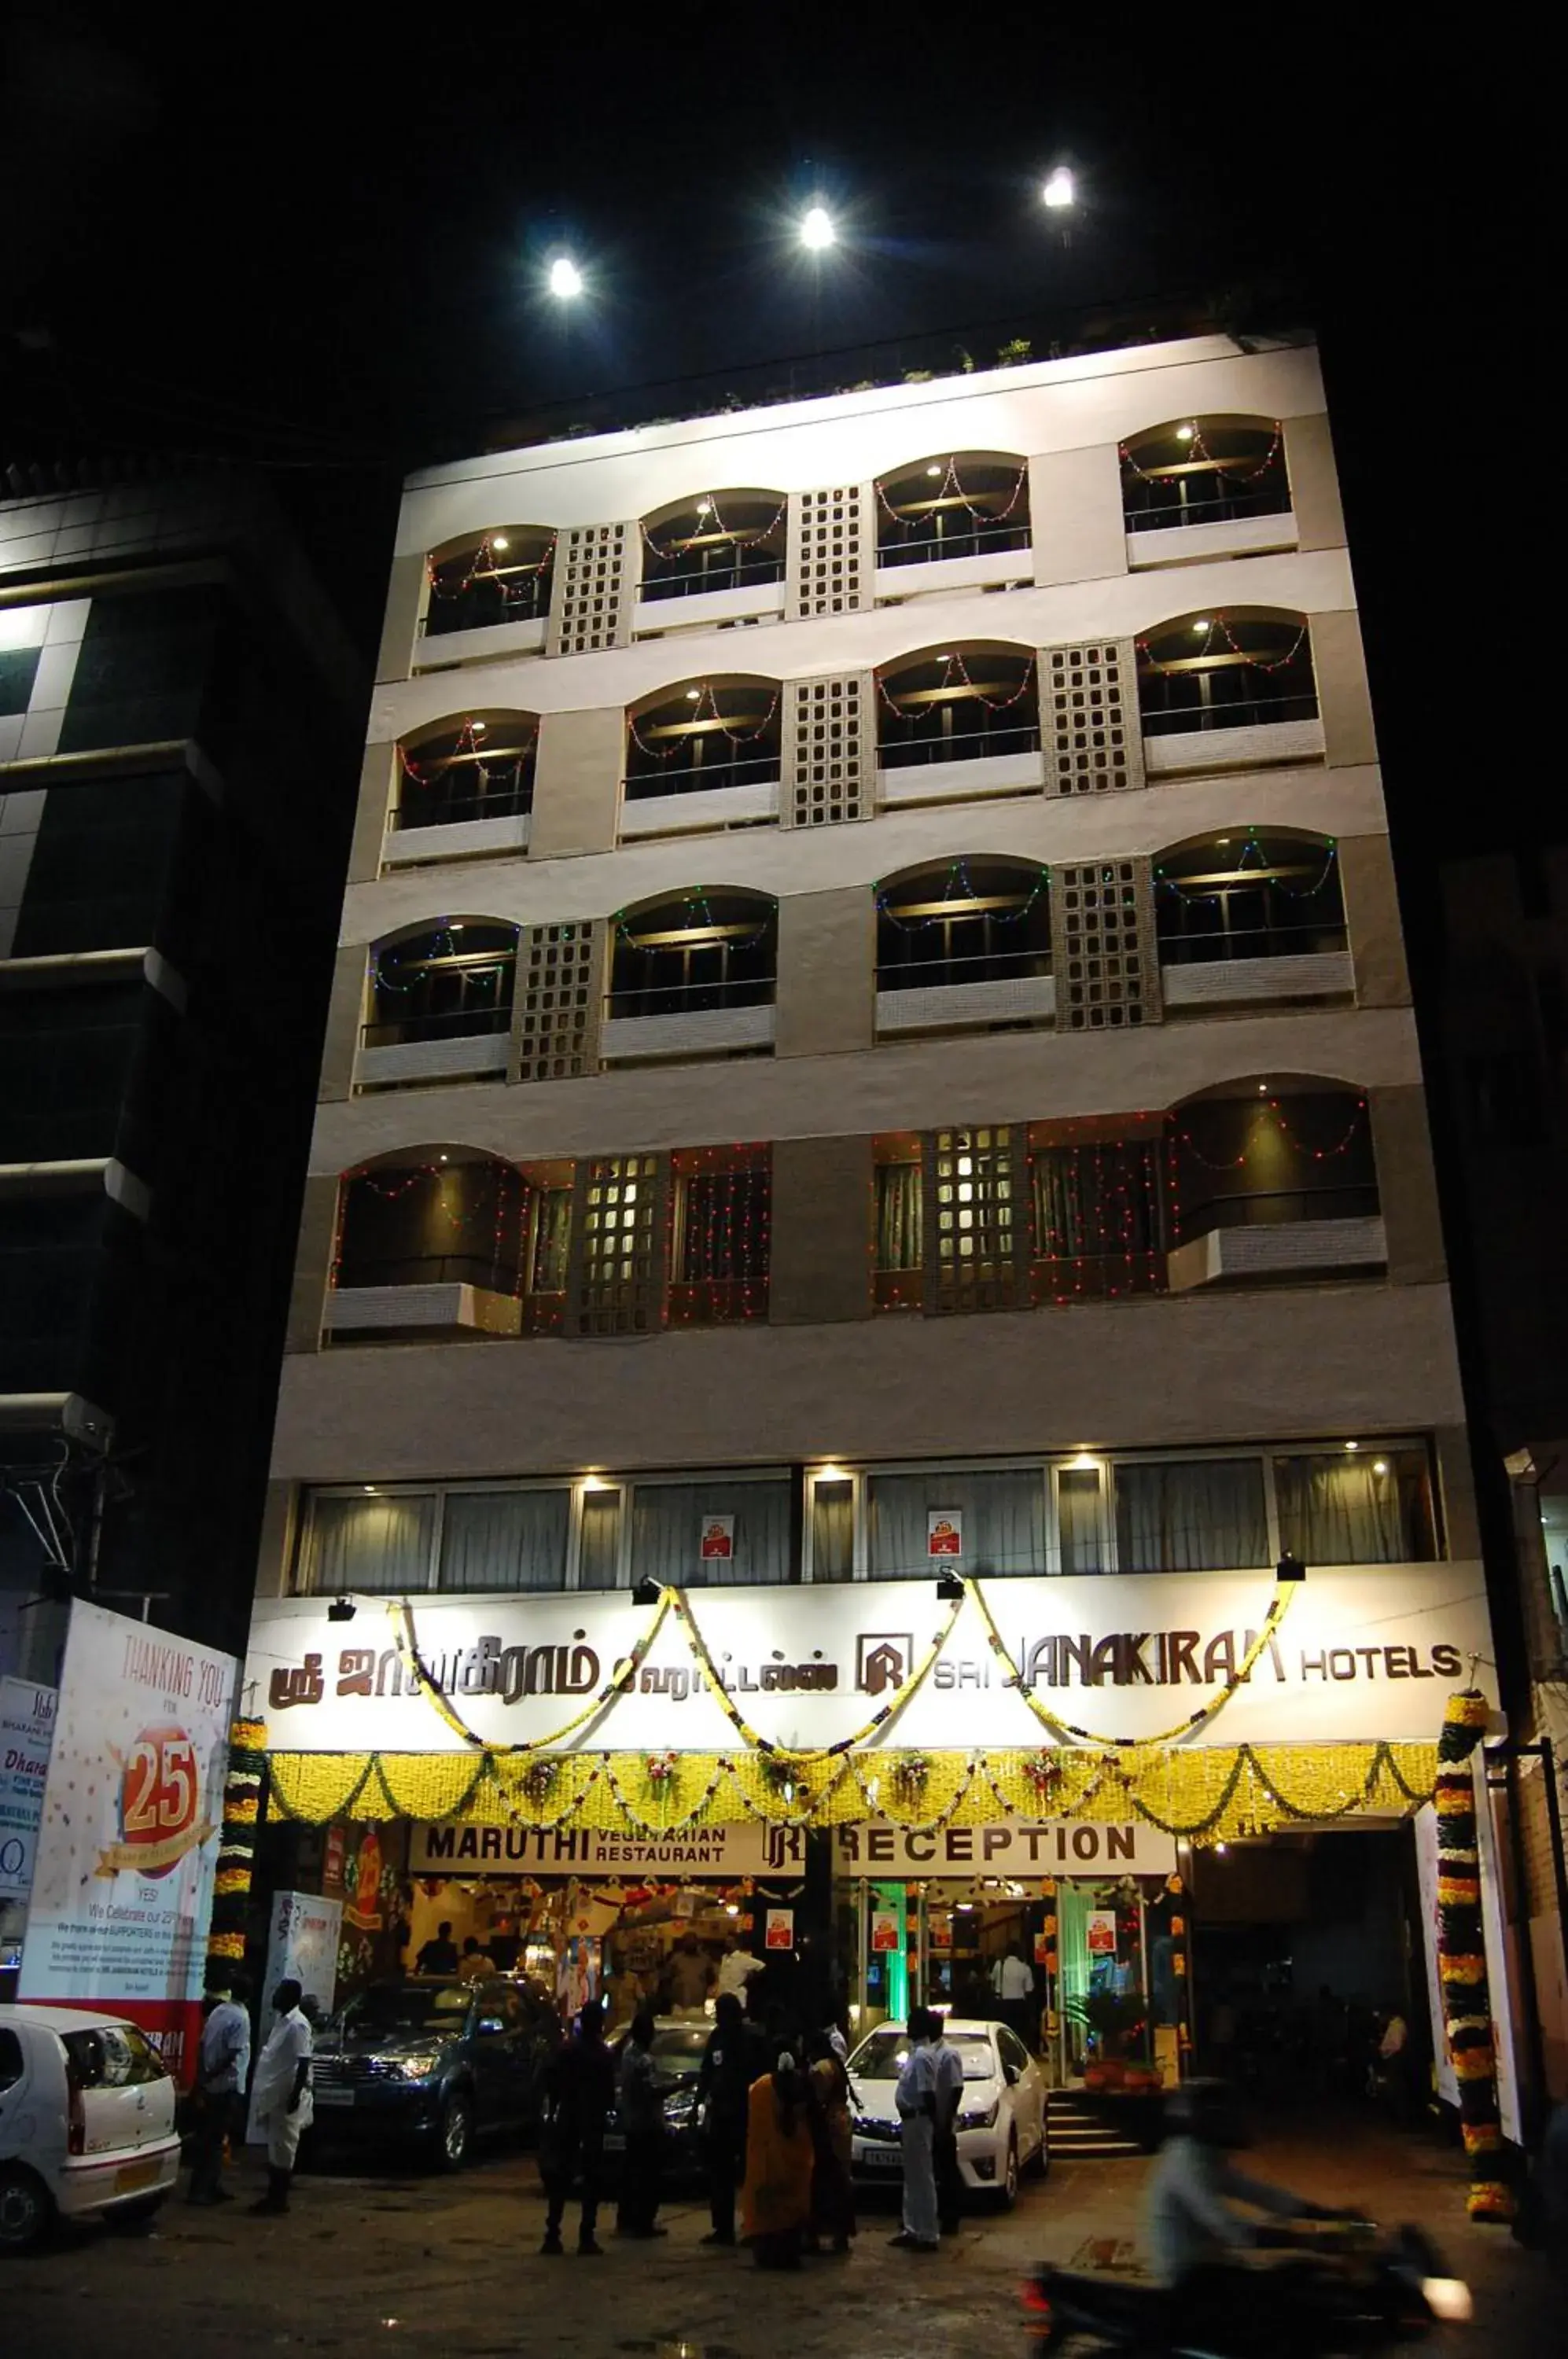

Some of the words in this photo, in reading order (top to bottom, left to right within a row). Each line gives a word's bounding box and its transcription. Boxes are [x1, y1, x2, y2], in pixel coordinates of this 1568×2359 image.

[122, 1635, 194, 1698] THANKING
[197, 1659, 225, 1708] YOU
[933, 1659, 990, 1690] SRI
[1301, 1643, 1463, 1682] HOTELS
[123, 1740, 190, 1832] 25
[426, 1827, 589, 1861] MARUTHI
[596, 1846, 725, 1862] RESTAURANT
[838, 1824, 1136, 1862] RECEPTION
